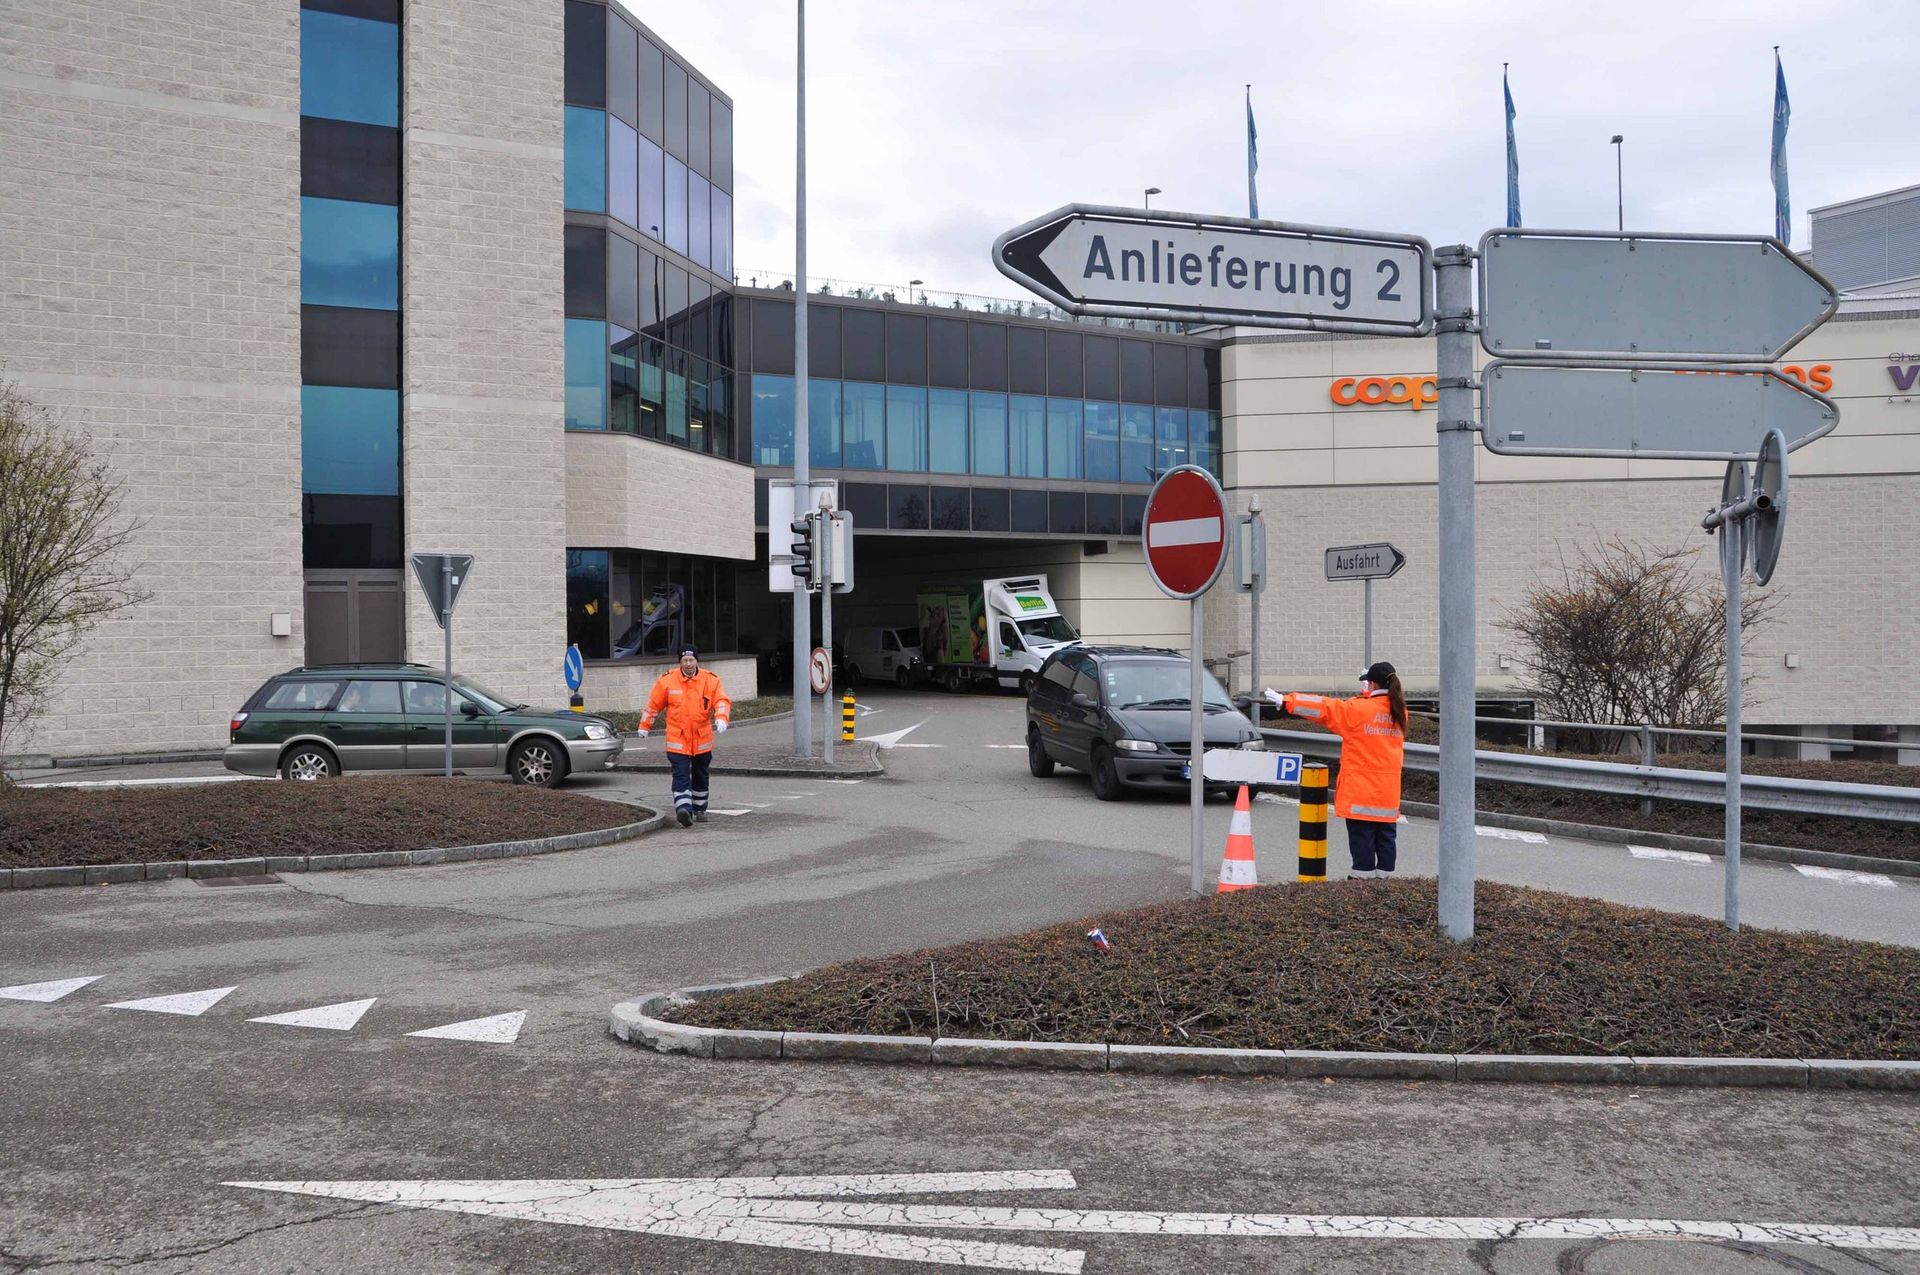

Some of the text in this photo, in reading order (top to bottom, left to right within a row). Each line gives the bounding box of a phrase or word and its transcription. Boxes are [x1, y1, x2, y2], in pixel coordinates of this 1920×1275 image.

[1083, 234, 1401, 310] Anlieferung 2
[1887, 365, 1920, 391] V
[1330, 376, 1439, 411] coop
[1336, 553, 1380, 570] Ausfahrt
[1281, 759, 1297, 779] P
